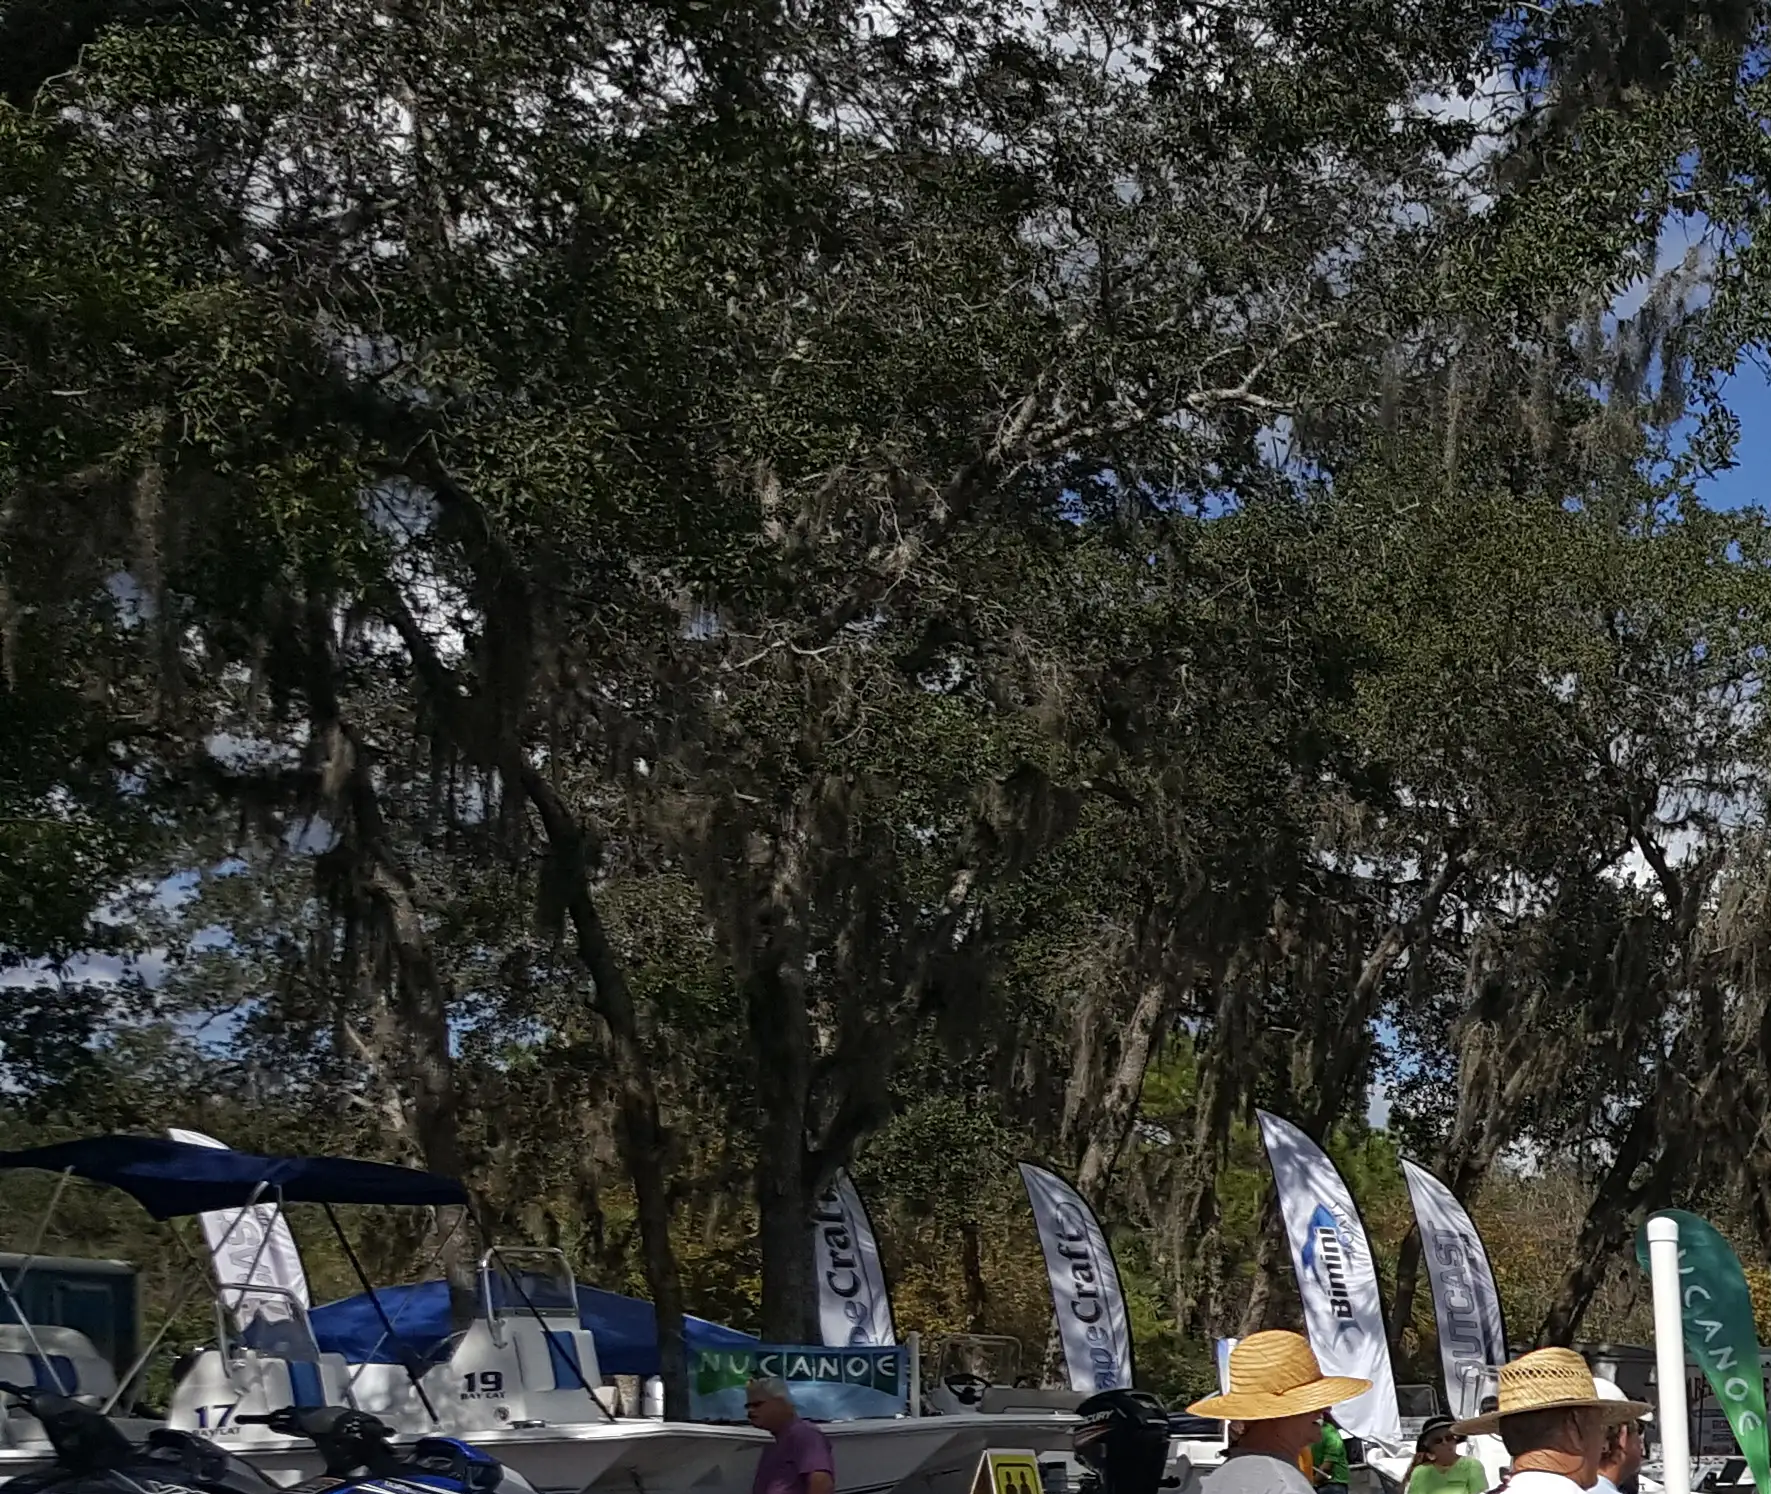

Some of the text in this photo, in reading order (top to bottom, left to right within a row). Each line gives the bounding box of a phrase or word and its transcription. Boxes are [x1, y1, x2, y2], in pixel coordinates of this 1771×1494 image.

[1315, 1226, 1354, 1319] Bimini
[1428, 1220, 1487, 1386] OUTCAST
[699, 1352, 897, 1378] NUCANOE
[1678, 1248, 1762, 1437] CANOE
[463, 1371, 503, 1393] 19
[194, 1403, 237, 1429] 17
